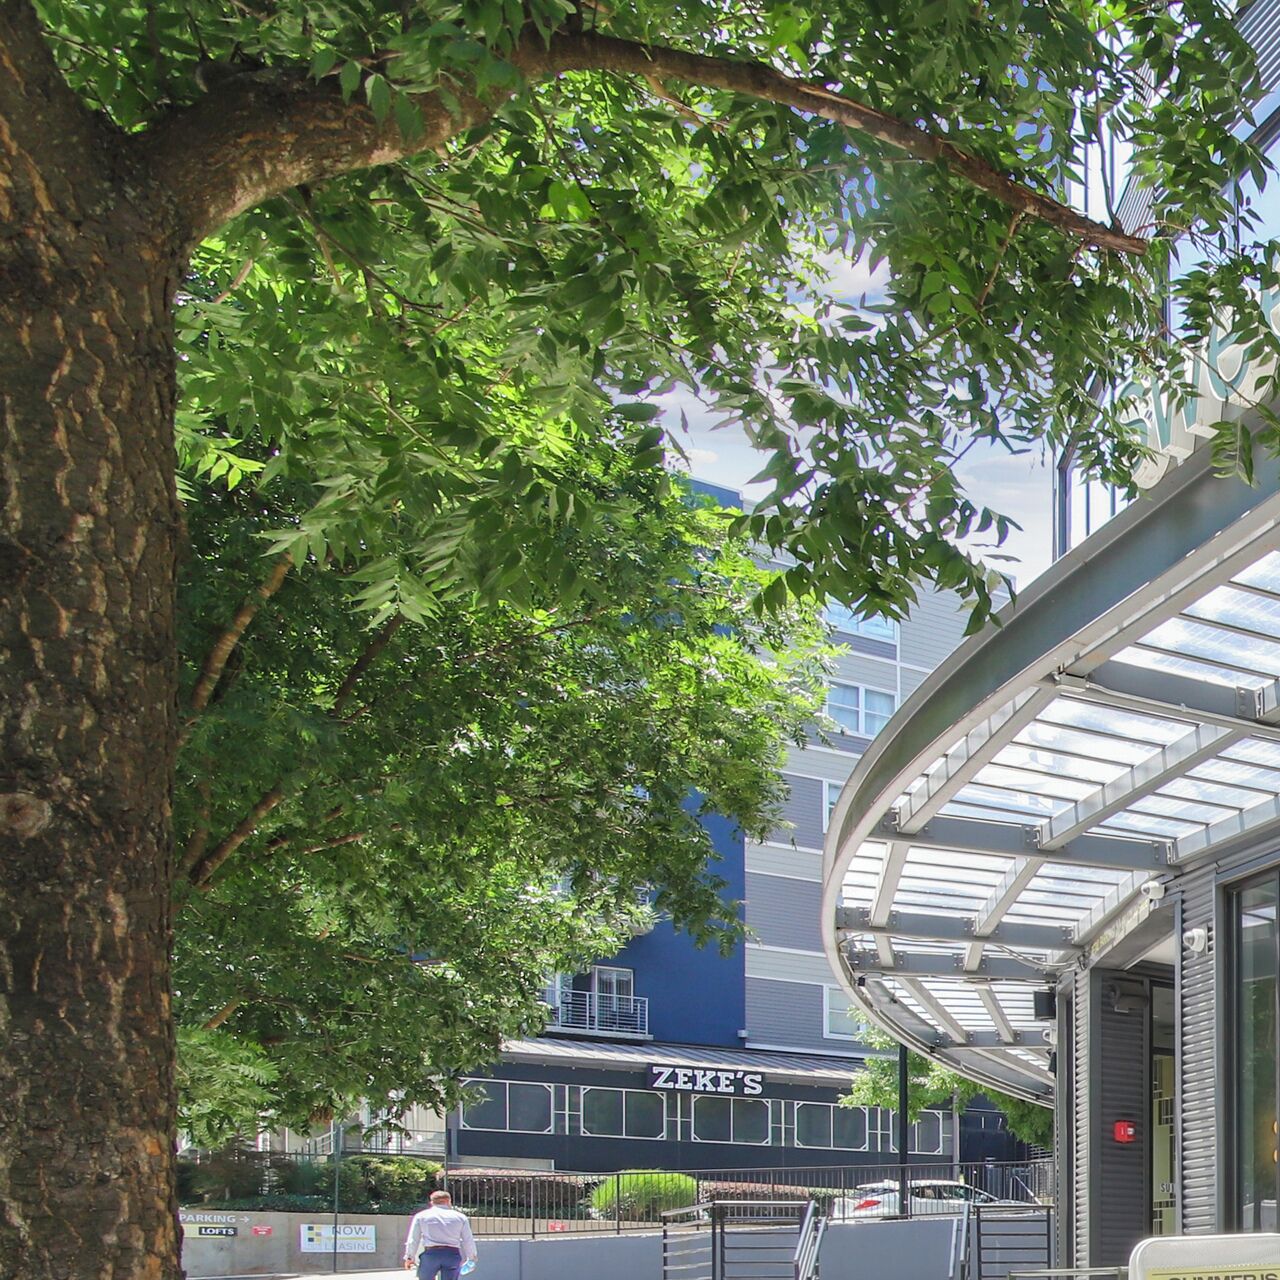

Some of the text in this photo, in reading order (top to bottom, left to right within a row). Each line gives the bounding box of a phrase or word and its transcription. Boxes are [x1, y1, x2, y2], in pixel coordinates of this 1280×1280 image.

[652, 1066, 763, 1095] ZEKE'S
[179, 1214, 236, 1223] PARKING
[201, 1228, 235, 1236] LOFTS
[332, 1225, 367, 1236] NOW
